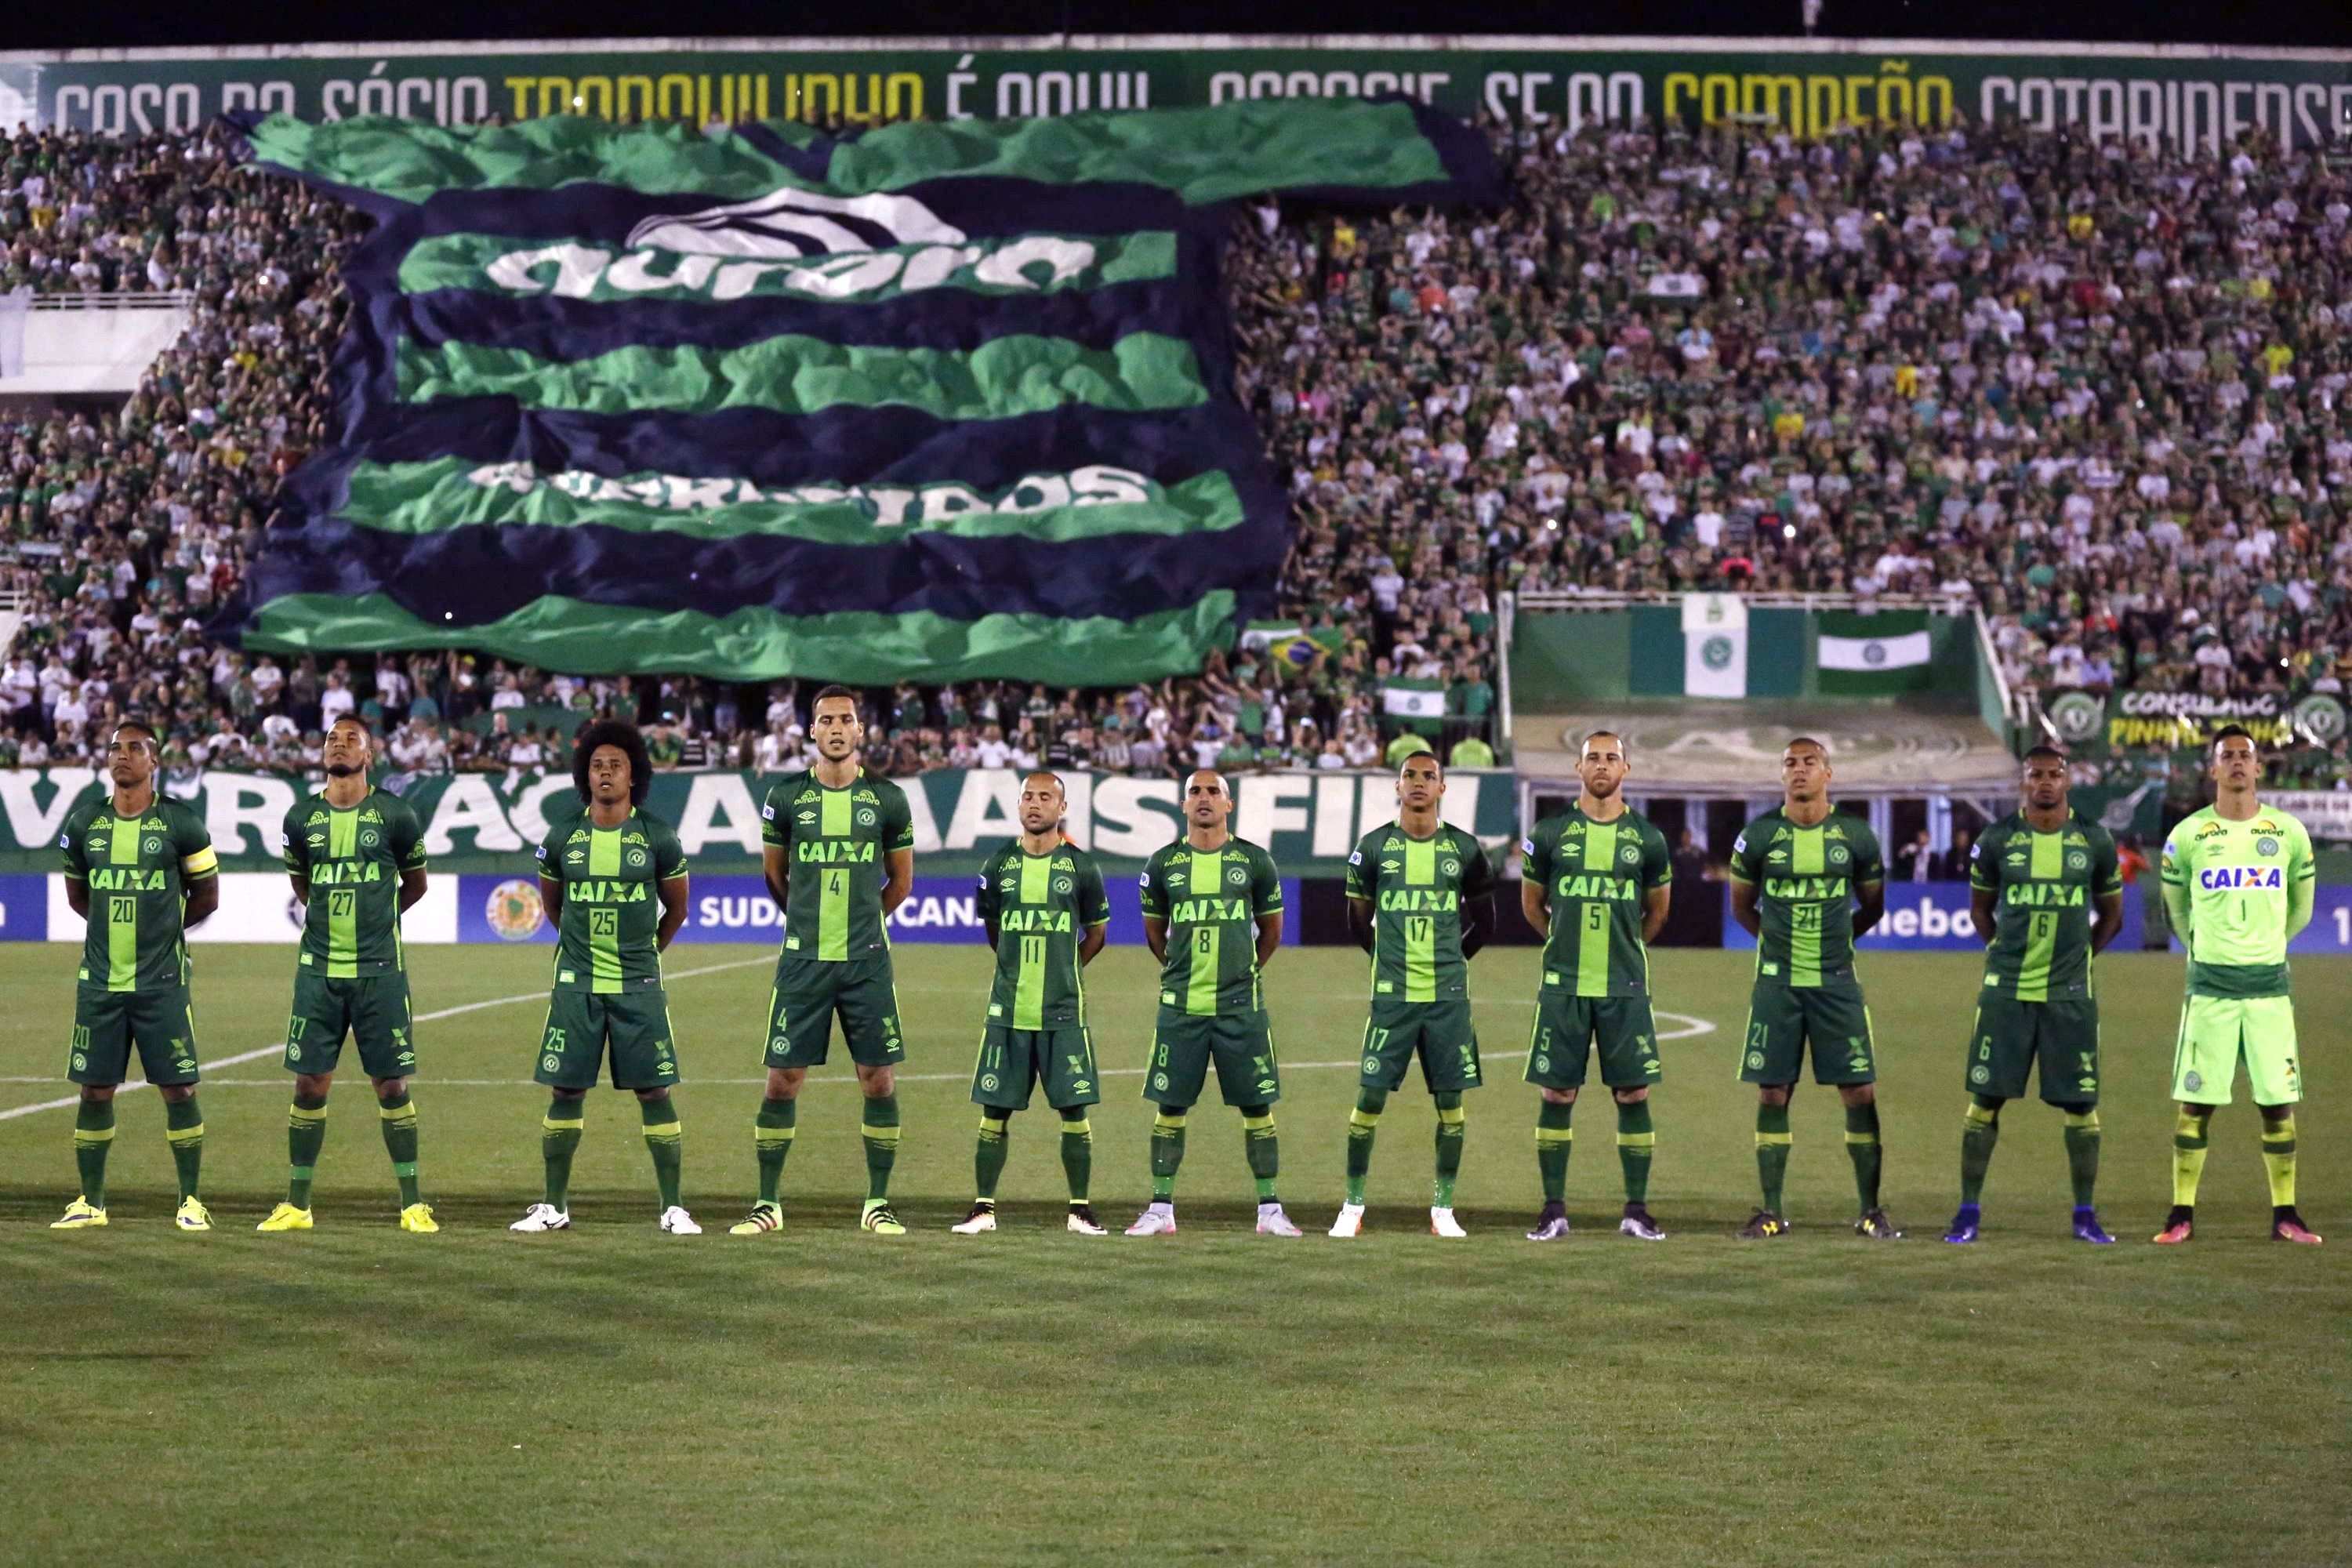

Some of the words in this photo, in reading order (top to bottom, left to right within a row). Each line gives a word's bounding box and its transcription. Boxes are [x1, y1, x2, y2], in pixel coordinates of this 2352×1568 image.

[794, 795, 821, 806] aurora
[852, 795, 880, 806] aurora
[798, 841, 875, 862] CAIXA
[89, 868, 166, 891] CAIXA
[829, 872, 840, 896] 4
[1559, 876, 1635, 901] CAIXA
[1766, 877, 1846, 898] CAIXA
[2201, 868, 2280, 889] CAIXA
[569, 881, 647, 902] CAIXA
[1381, 891, 1457, 911] CAIXA
[2007, 884, 2084, 906] CAIXA
[112, 899, 134, 924] 20
[332, 892, 354, 916] 27
[1173, 899, 1246, 923] CAIXA
[2241, 899, 2246, 922] 1
[593, 911, 615, 936] 25
[1411, 917, 1428, 942] 17
[1590, 906, 1600, 930] 5
[2038, 913, 2049, 938] 6
[1025, 938, 1040, 964] 11
[1199, 929, 1210, 953] 8
[290, 1015, 307, 1040] 27
[776, 1007, 788, 1033] 4
[545, 1027, 566, 1053] 25
[1369, 1027, 1389, 1052] 17
[1541, 1027, 1552, 1052] 5
[1750, 1022, 1769, 1049] 21
[985, 1044, 1002, 1070] 11
[1158, 1044, 1169, 1068] 8
[1979, 1035, 1992, 1062] 6
